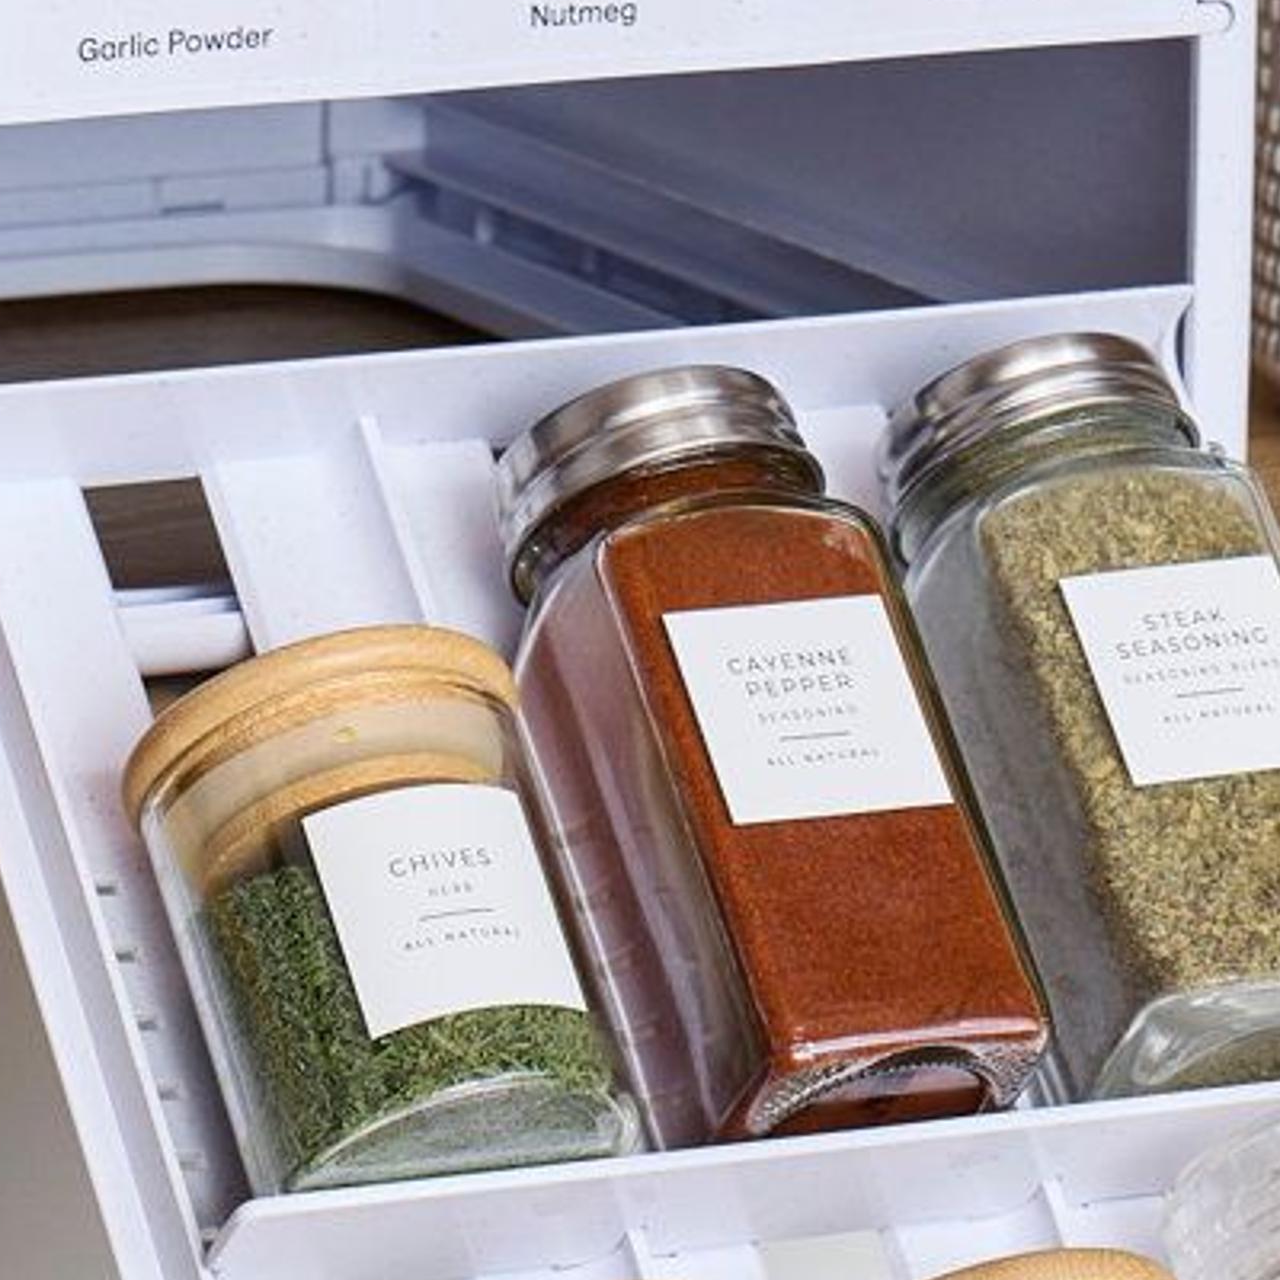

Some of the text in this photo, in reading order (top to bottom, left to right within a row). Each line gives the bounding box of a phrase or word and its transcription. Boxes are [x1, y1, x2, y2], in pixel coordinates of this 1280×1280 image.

[530, 2, 638, 29] Nutmeg
[77, 27, 274, 63] Garlic Powder
[1143, 608, 1226, 630] STEAK
[1117, 627, 1269, 659] SEASONING
[728, 647, 852, 674] CAYENNE
[746, 674, 856, 697] PEPPER
[389, 847, 491, 876] CHIVES
